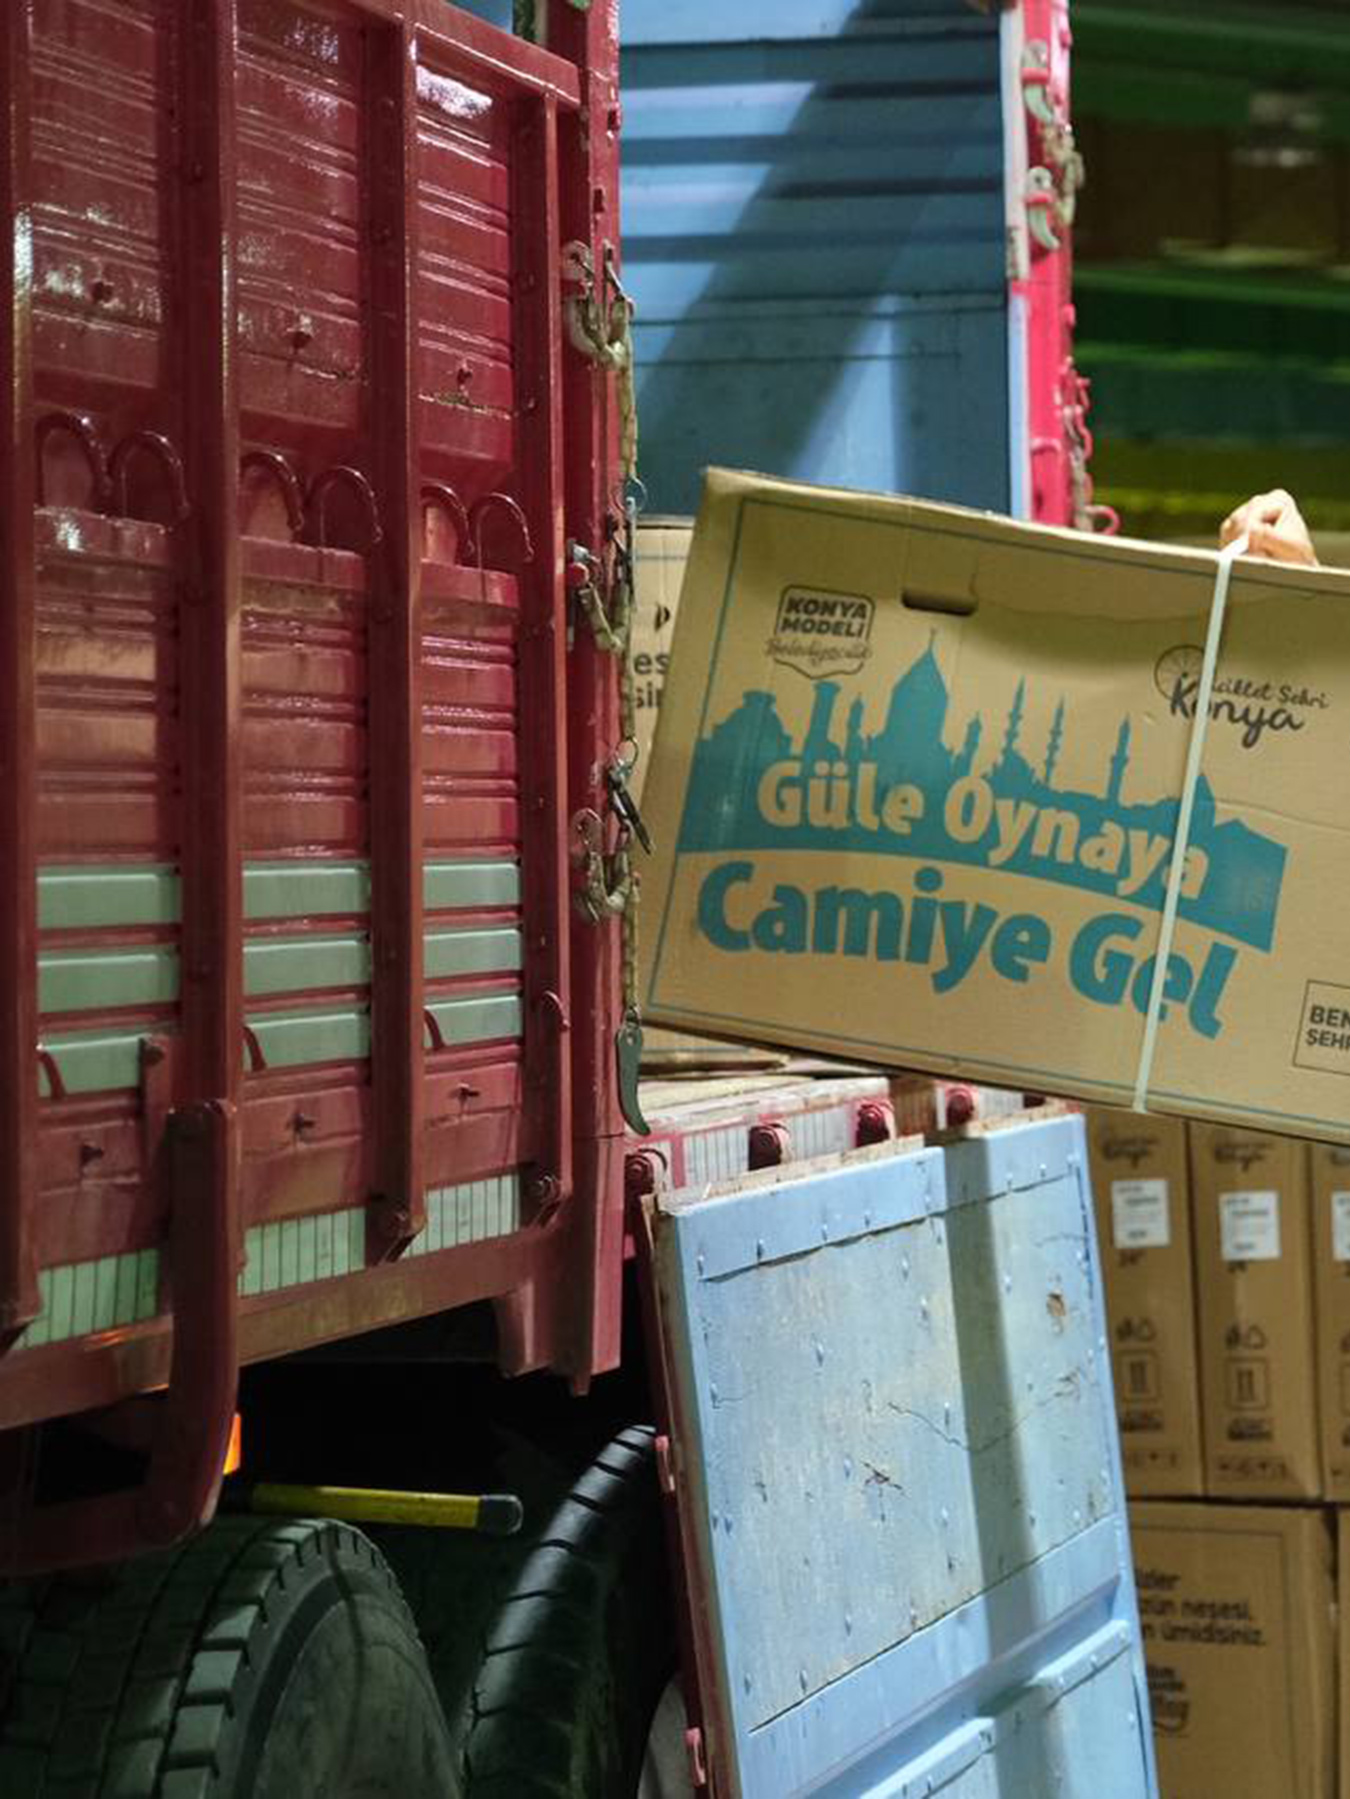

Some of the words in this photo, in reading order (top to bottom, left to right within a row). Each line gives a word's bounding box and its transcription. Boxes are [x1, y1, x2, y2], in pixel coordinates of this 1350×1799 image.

[785, 597, 867, 620] KONYA
[757, 760, 924, 834] Güle
[944, 775, 1209, 899] Oynaya
[698, 860, 1053, 996] Camiye
[1068, 912, 1239, 1040] Gel
